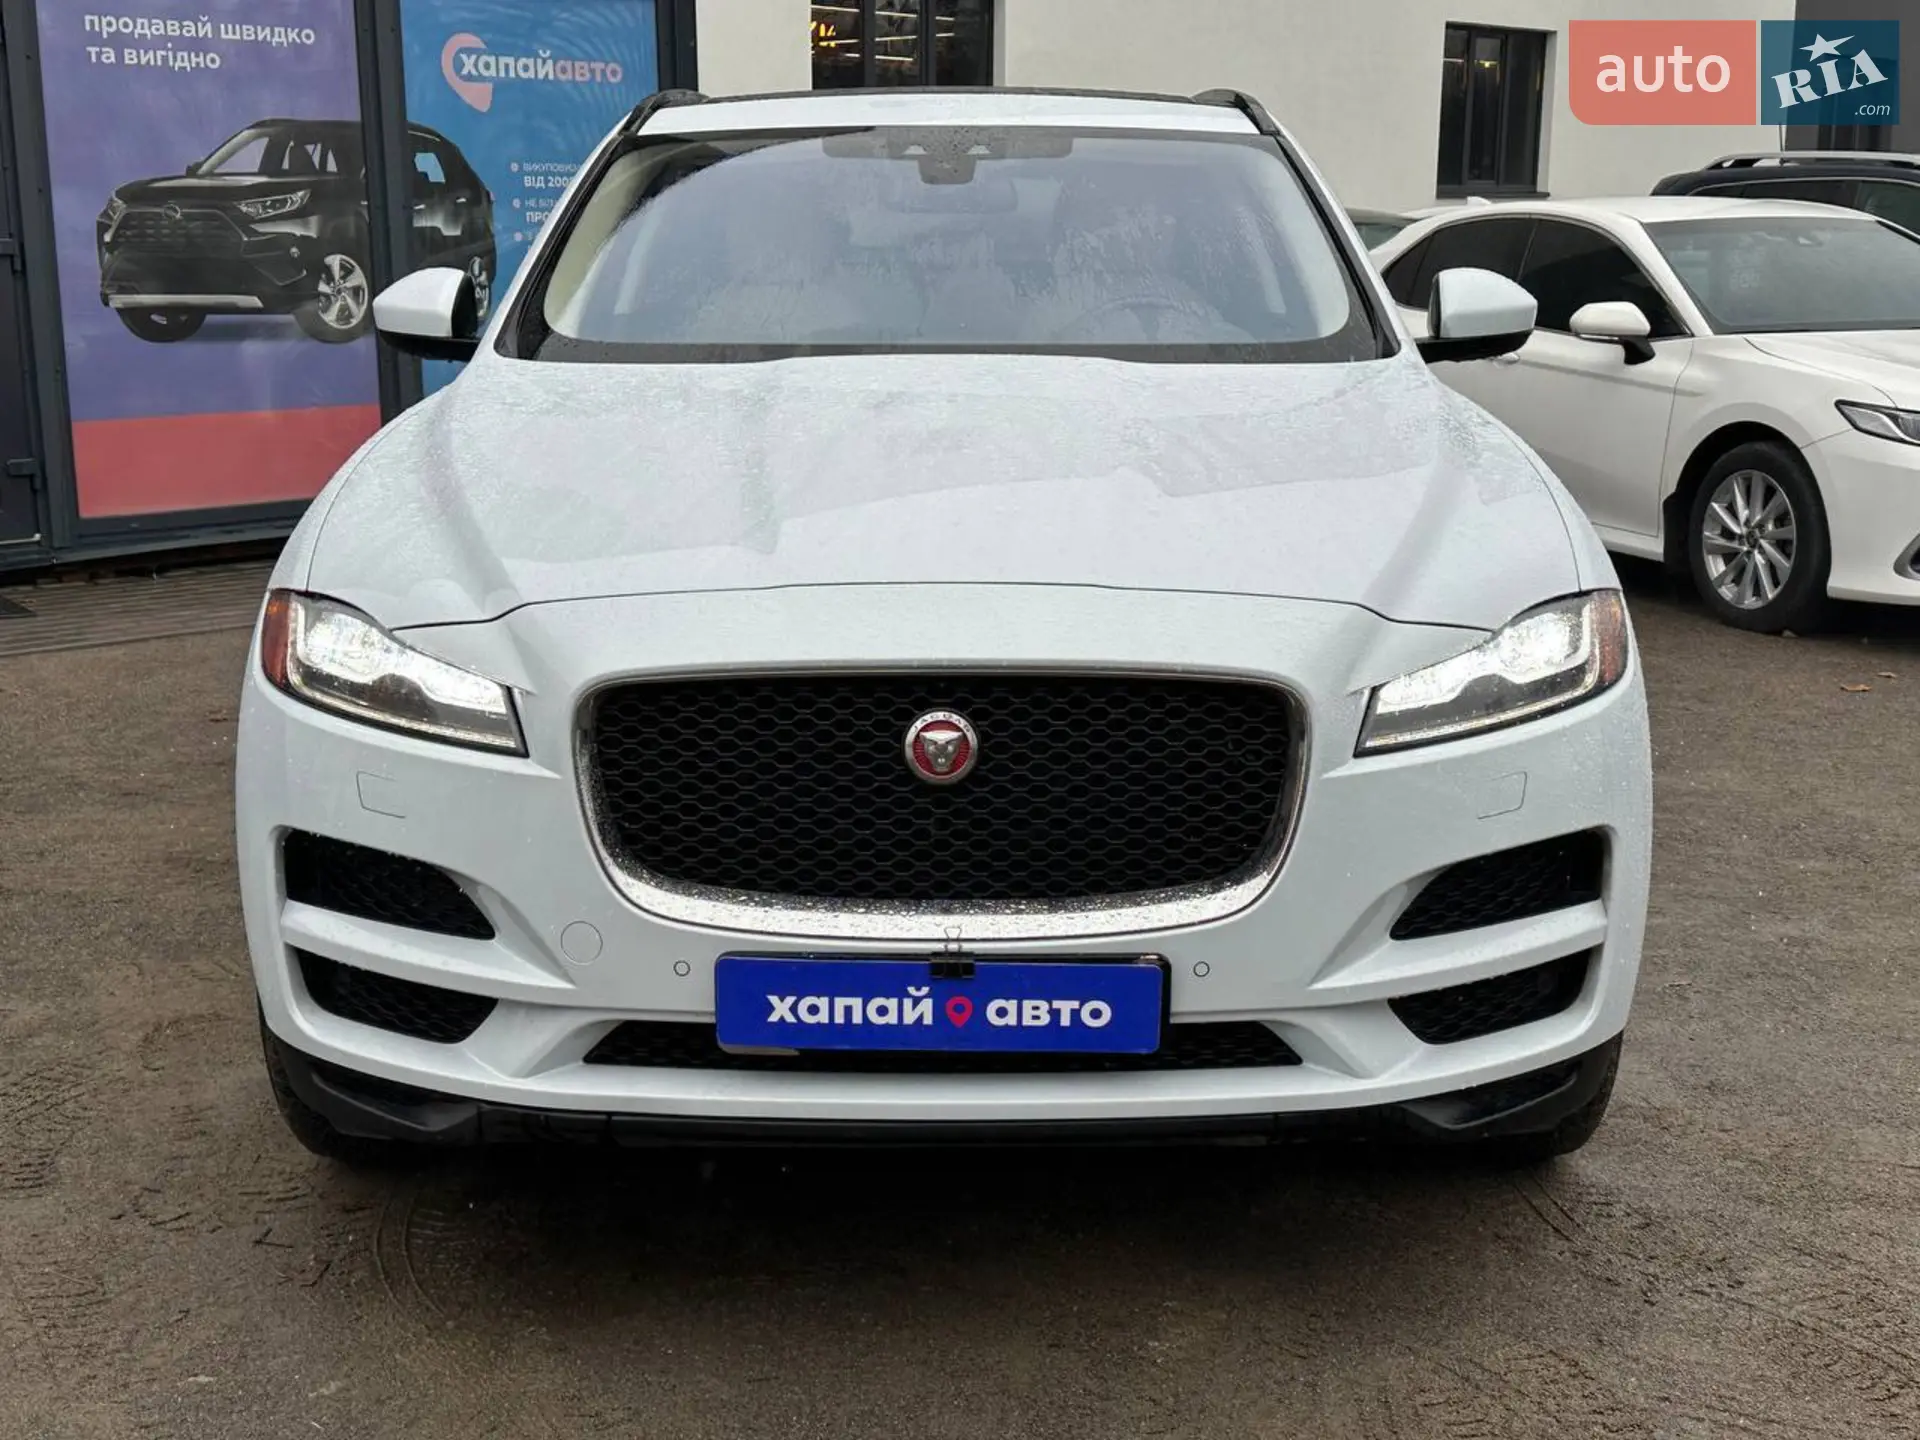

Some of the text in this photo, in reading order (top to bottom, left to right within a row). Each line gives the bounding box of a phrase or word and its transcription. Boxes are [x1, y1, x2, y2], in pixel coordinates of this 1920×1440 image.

[84, 14, 316, 47] продавай швидко
[86, 42, 221, 71] та вигідно
[524, 176, 545, 189] ВІД
[766, 986, 1112, 1028] хапай авто
